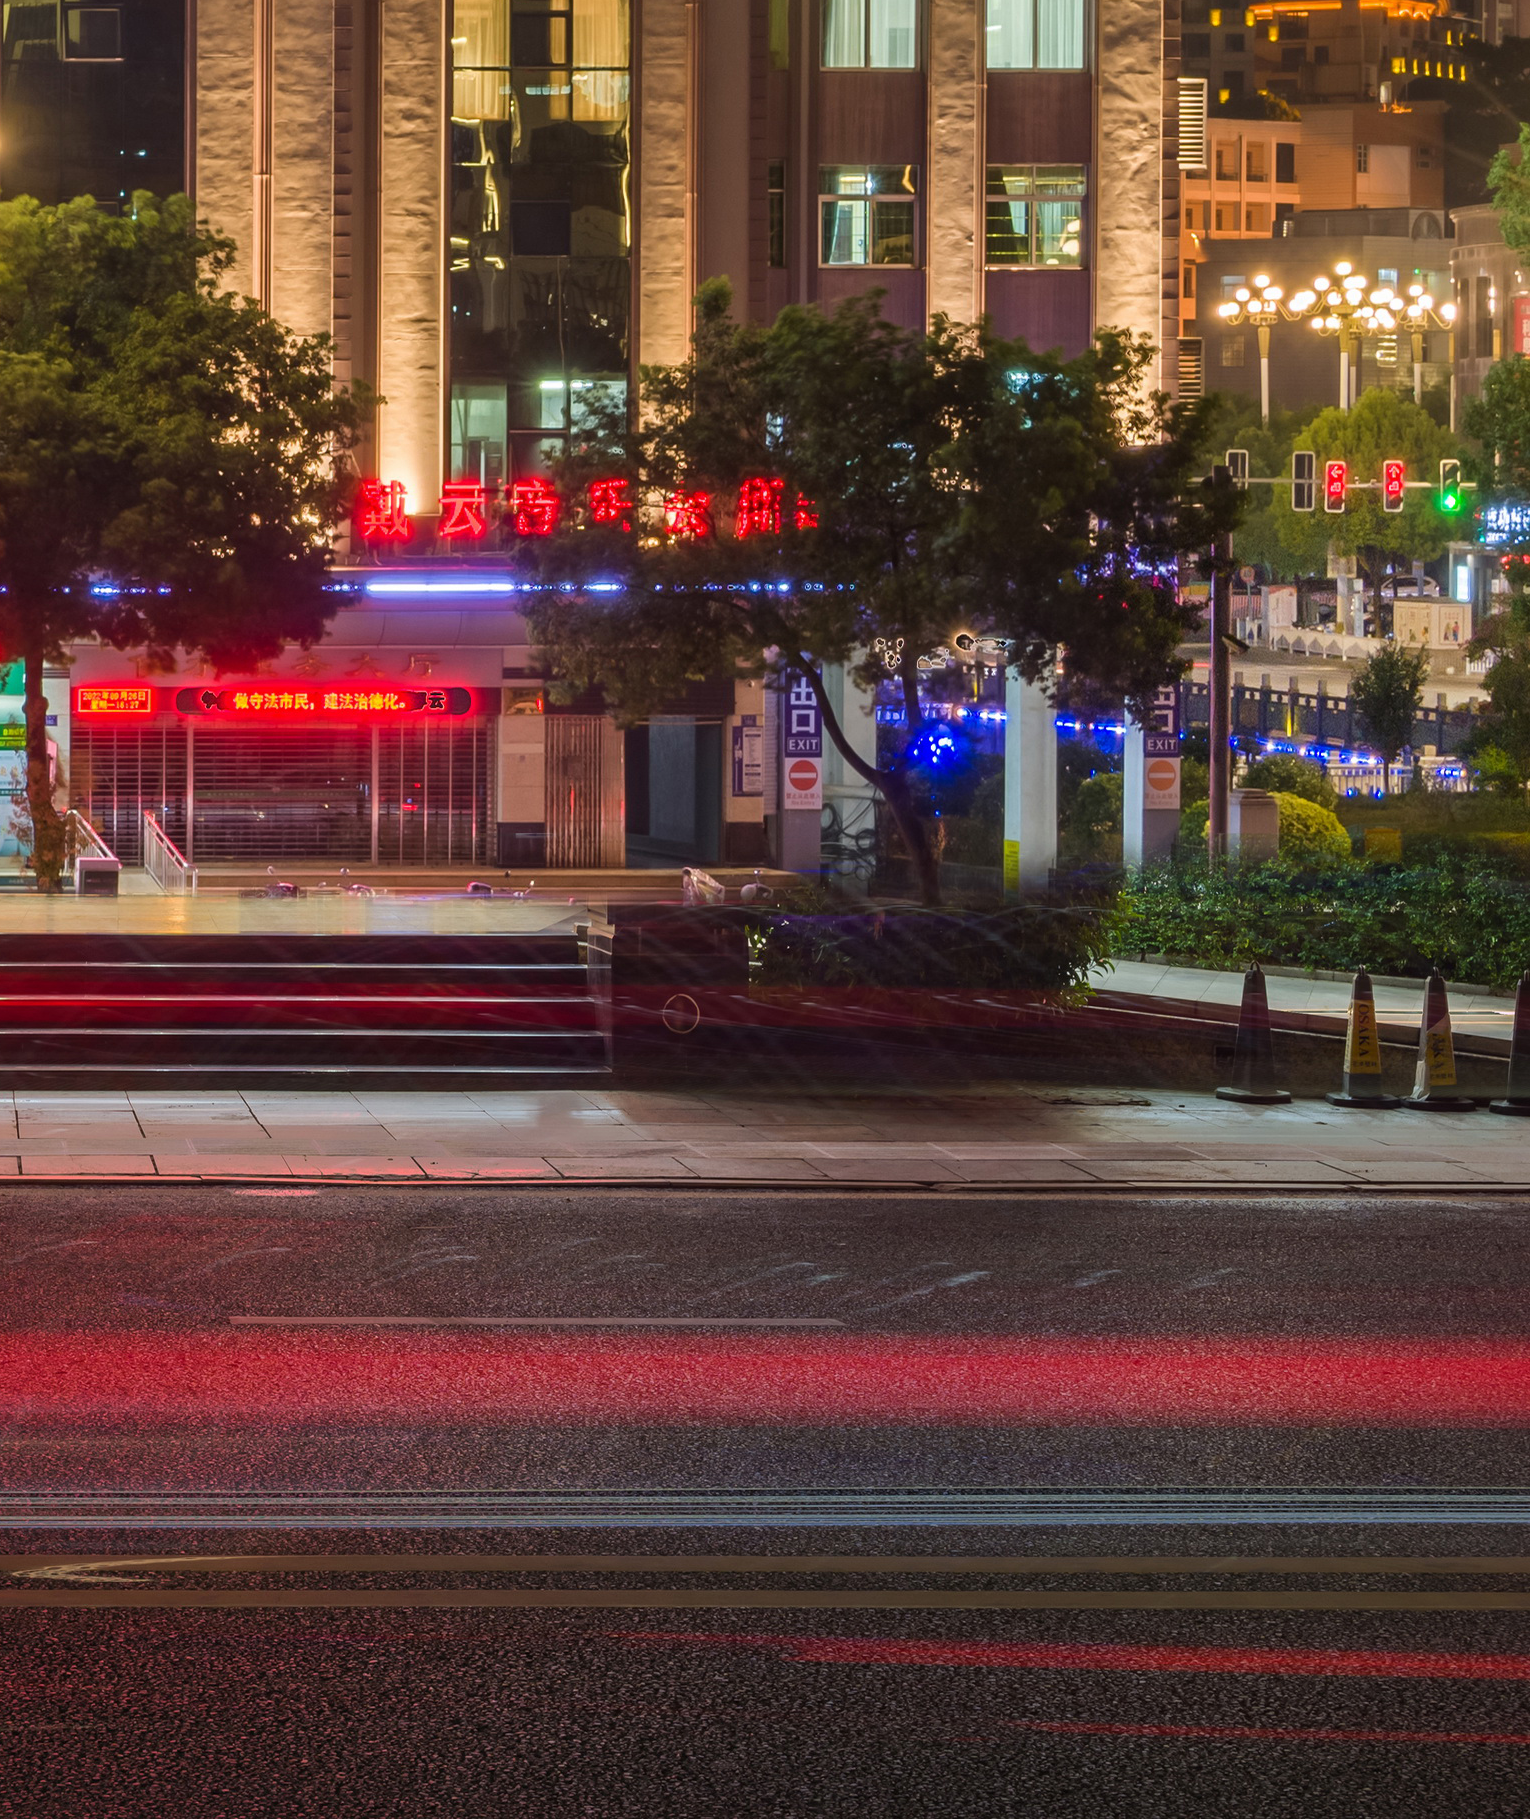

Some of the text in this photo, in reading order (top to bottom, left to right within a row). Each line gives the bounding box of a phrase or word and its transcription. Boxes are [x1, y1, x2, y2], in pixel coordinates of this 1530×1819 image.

[790, 676, 818, 734] 出口
[789, 739, 818, 750] EXIT
[1147, 739, 1177, 751] EXIT
